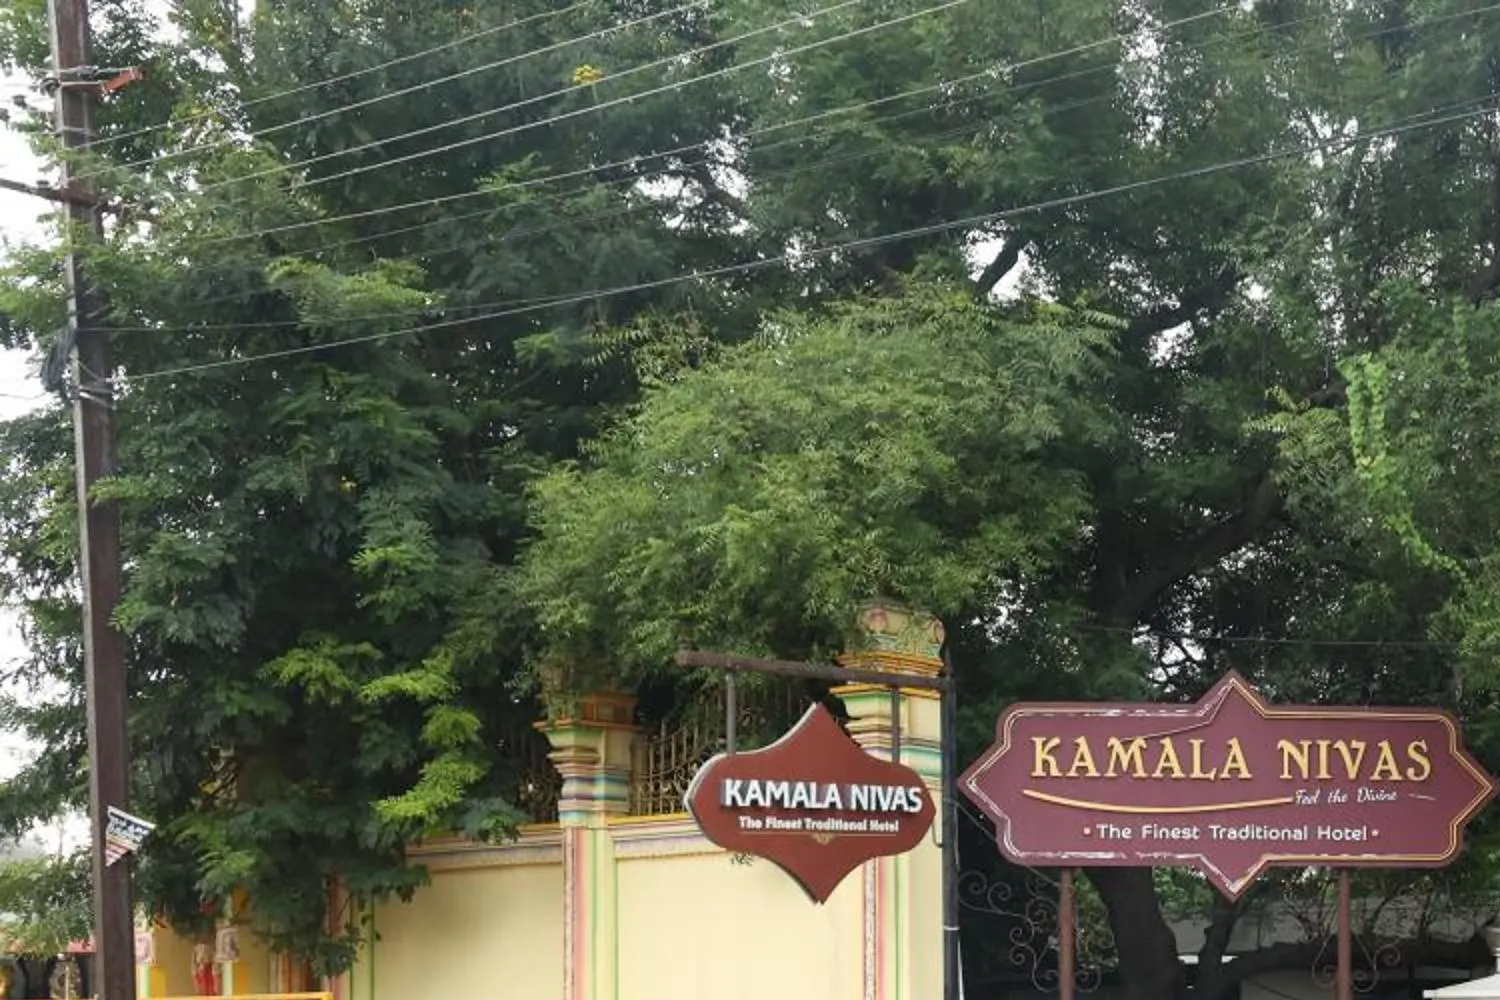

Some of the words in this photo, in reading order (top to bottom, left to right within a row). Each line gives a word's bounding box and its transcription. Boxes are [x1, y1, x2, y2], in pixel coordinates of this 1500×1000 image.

[1030, 735, 1253, 781] KAMALA
[1277, 738, 1433, 781] NIVAS
[724, 779, 843, 810] KAMALA
[850, 783, 923, 813] NIVAS
[1327, 787, 1348, 804] the
[1357, 786, 1398, 803] Divine
[739, 815, 763, 829] The
[765, 816, 802, 830] Finest
[804, 818, 867, 831] Traditional
[869, 820, 900, 833] Hotel
[1095, 823, 1133, 840] The
[1141, 823, 1200, 841] Finest
[1209, 824, 1308, 841] Traditional
[1317, 825, 1368, 842] Hotel
